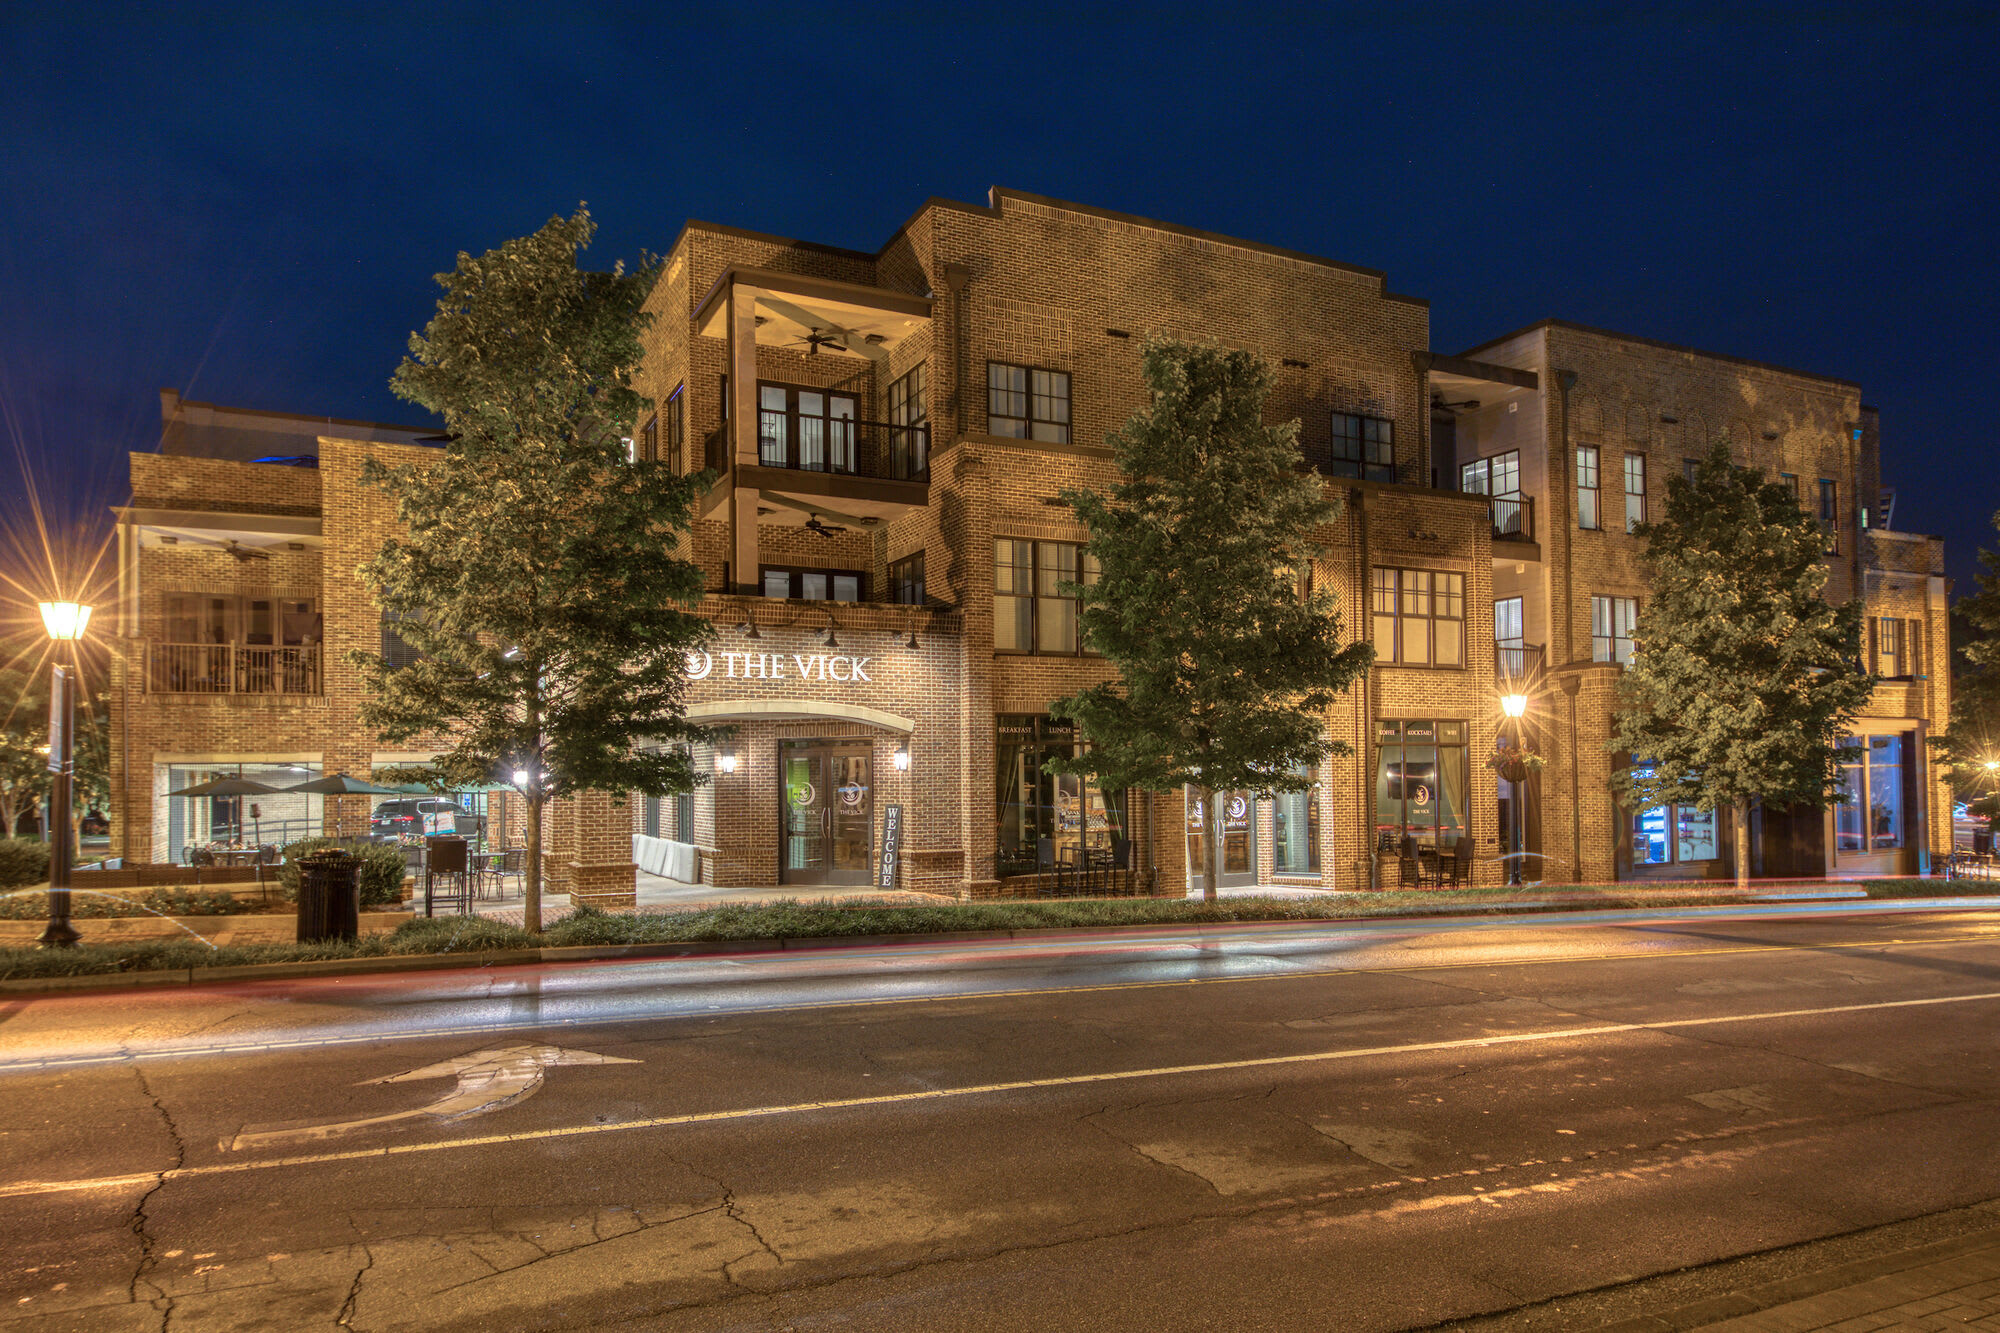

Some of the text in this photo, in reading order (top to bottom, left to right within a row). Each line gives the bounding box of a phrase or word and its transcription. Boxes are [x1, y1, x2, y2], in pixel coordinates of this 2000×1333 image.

[720, 652, 873, 682] THE VICK
[882, 807, 898, 886] WELCOME
